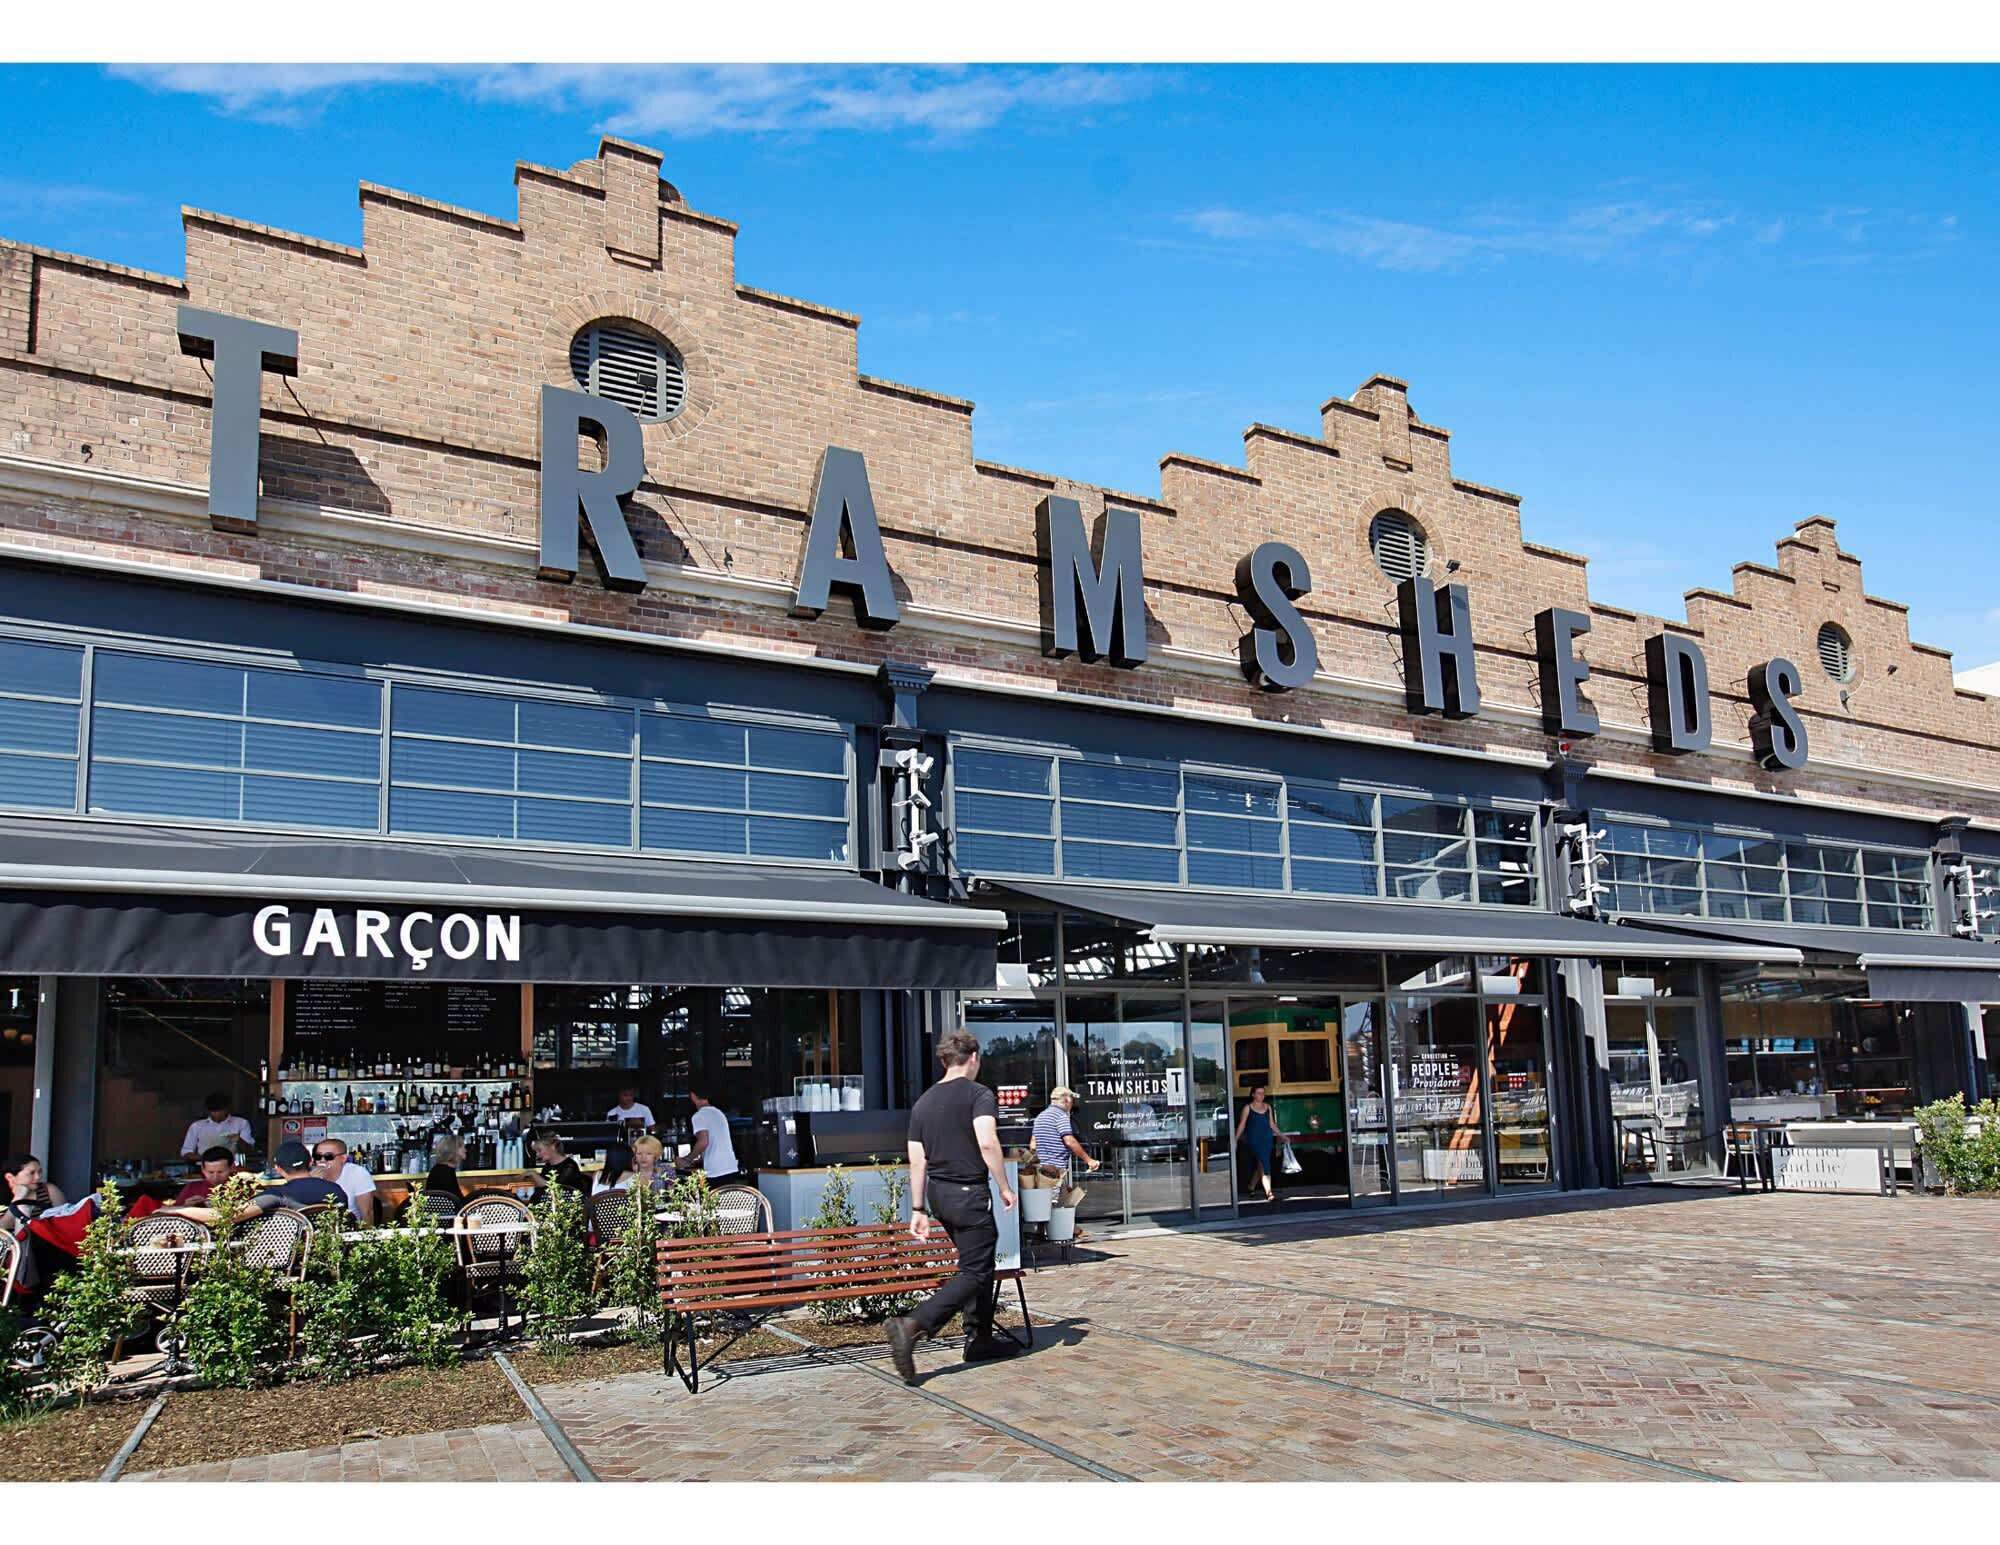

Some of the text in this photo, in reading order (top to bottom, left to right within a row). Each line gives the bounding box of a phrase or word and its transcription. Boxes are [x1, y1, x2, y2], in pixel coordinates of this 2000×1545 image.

[177, 306, 1807, 771] TRAMSHEDS
[252, 904, 521, 971] GARÇON
[1110, 1056, 1145, 1065] Welcome to
[1411, 1063, 1450, 1077] PEOPLE
[1087, 1079, 1168, 1096] TRAMSHEDS
[1170, 1072, 1182, 1093] T
[1412, 1076, 1461, 1089] Providores
[1780, 1159, 1841, 1173] and the
